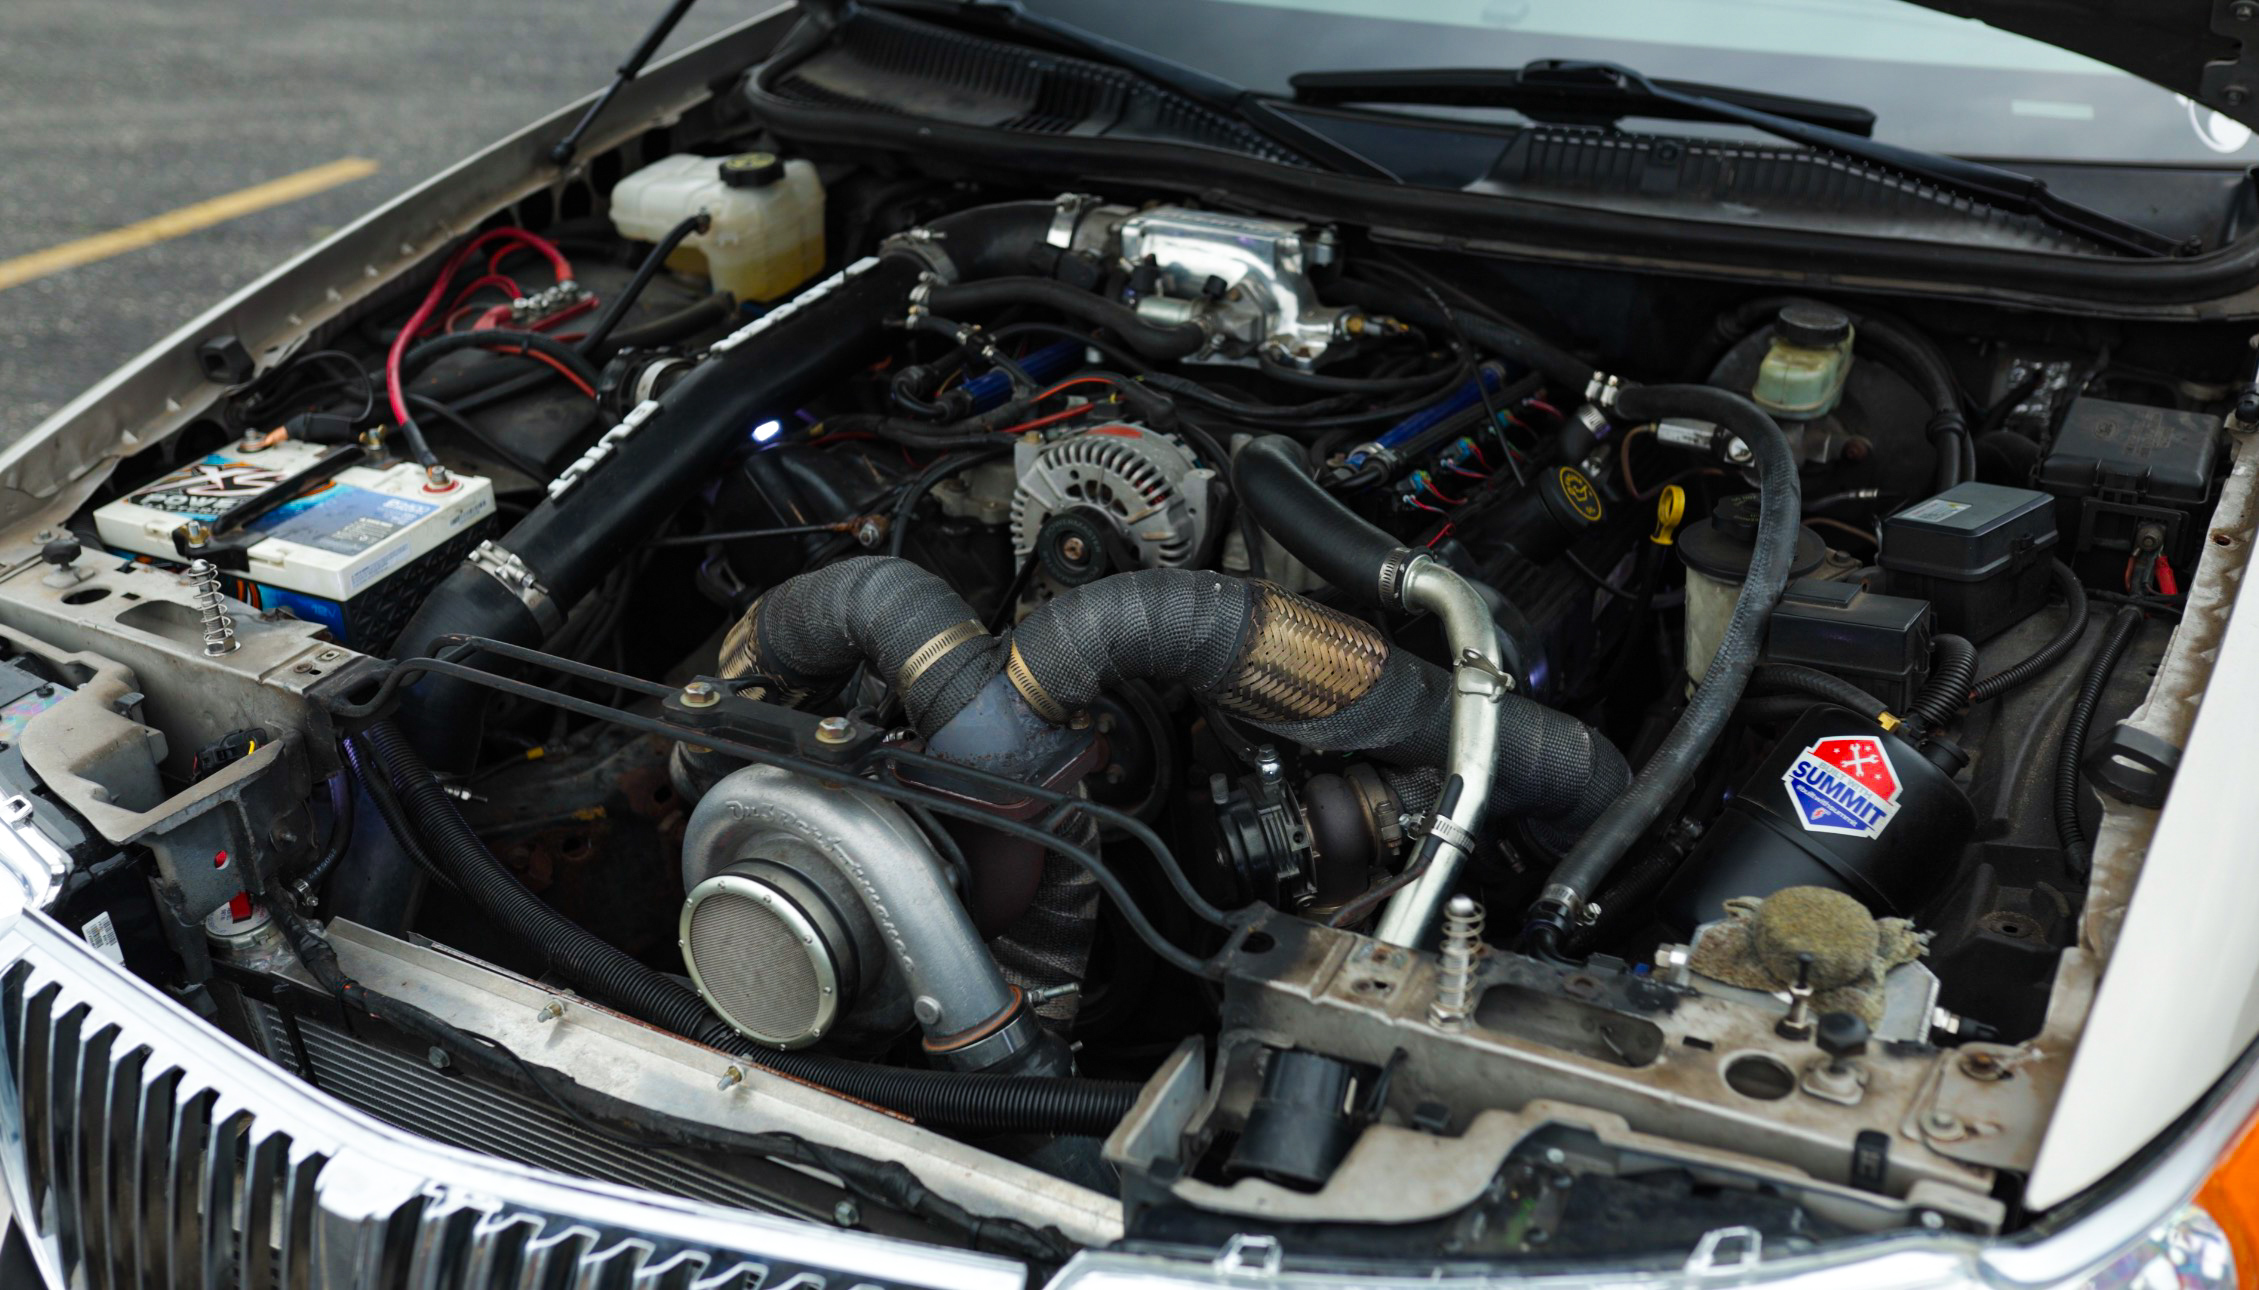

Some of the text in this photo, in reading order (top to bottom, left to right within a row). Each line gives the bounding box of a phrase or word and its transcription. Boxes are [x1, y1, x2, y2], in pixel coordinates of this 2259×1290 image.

[547, 400, 660, 500] BUILT
[1792, 760, 1887, 826] SUMMIT
[1819, 761, 1874, 800] BUILT WITH
